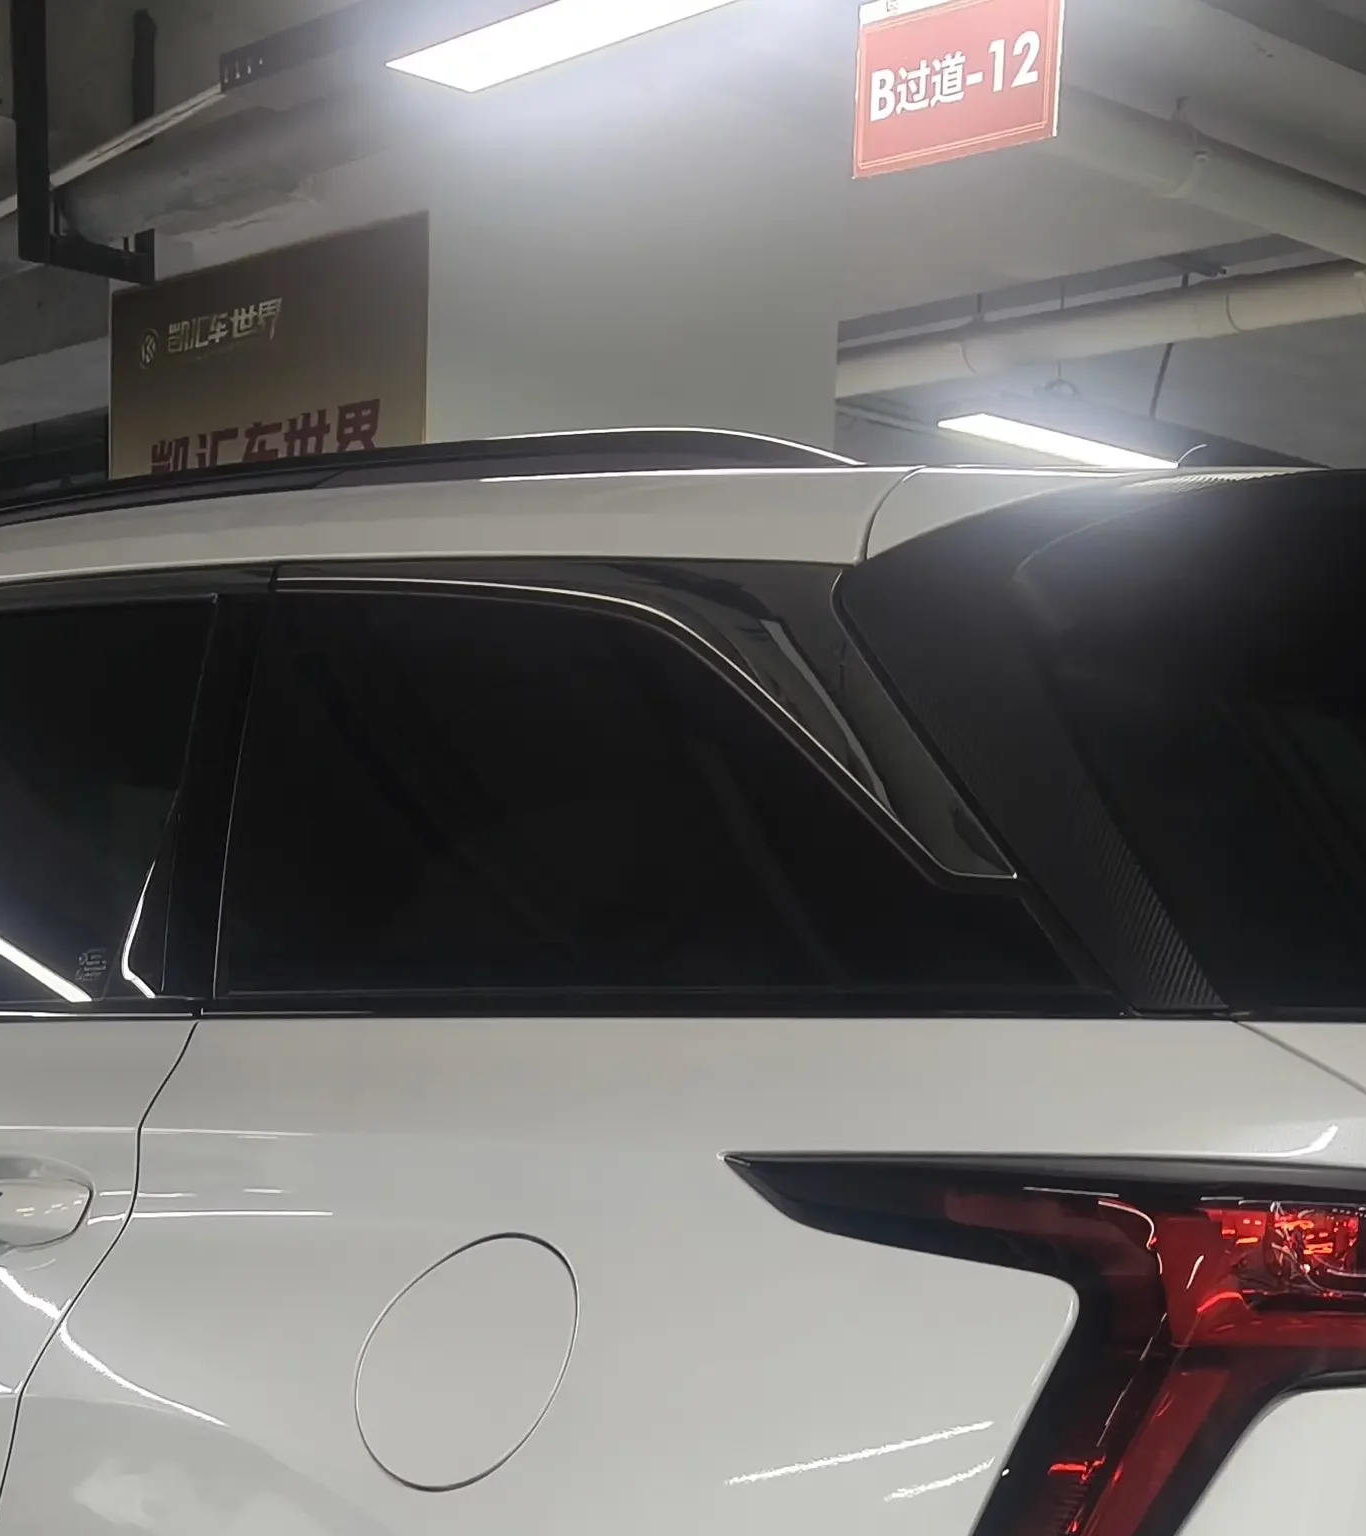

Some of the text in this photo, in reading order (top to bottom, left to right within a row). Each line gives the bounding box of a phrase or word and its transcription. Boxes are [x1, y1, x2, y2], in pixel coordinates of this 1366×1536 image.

[870, 30, 1041, 122] B过道-12
[167, 298, 283, 354] 凯汇车世界
